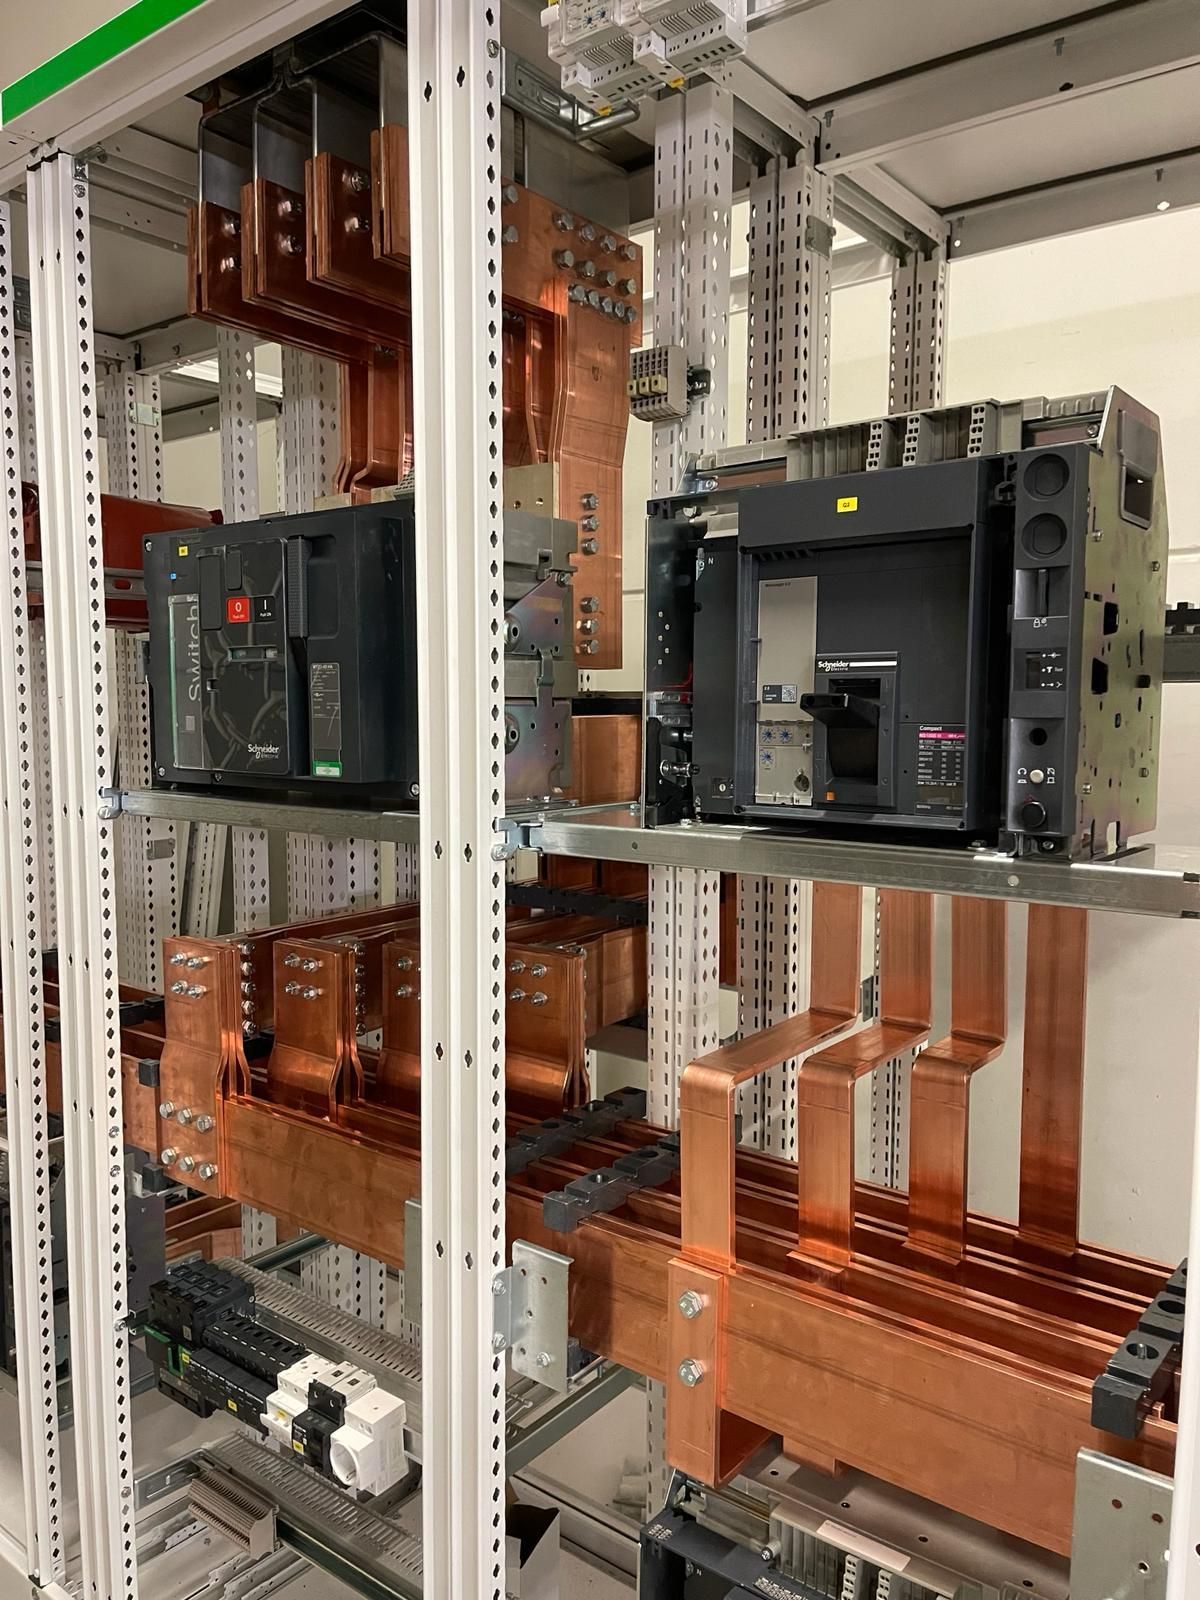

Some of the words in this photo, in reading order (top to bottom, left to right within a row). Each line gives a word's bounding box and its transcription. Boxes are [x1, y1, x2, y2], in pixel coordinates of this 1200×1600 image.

[707, 556, 714, 565] N
[186, 604, 200, 702] Switch
[817, 660, 849, 672] Schneider
[247, 743, 280, 759] Schneider
